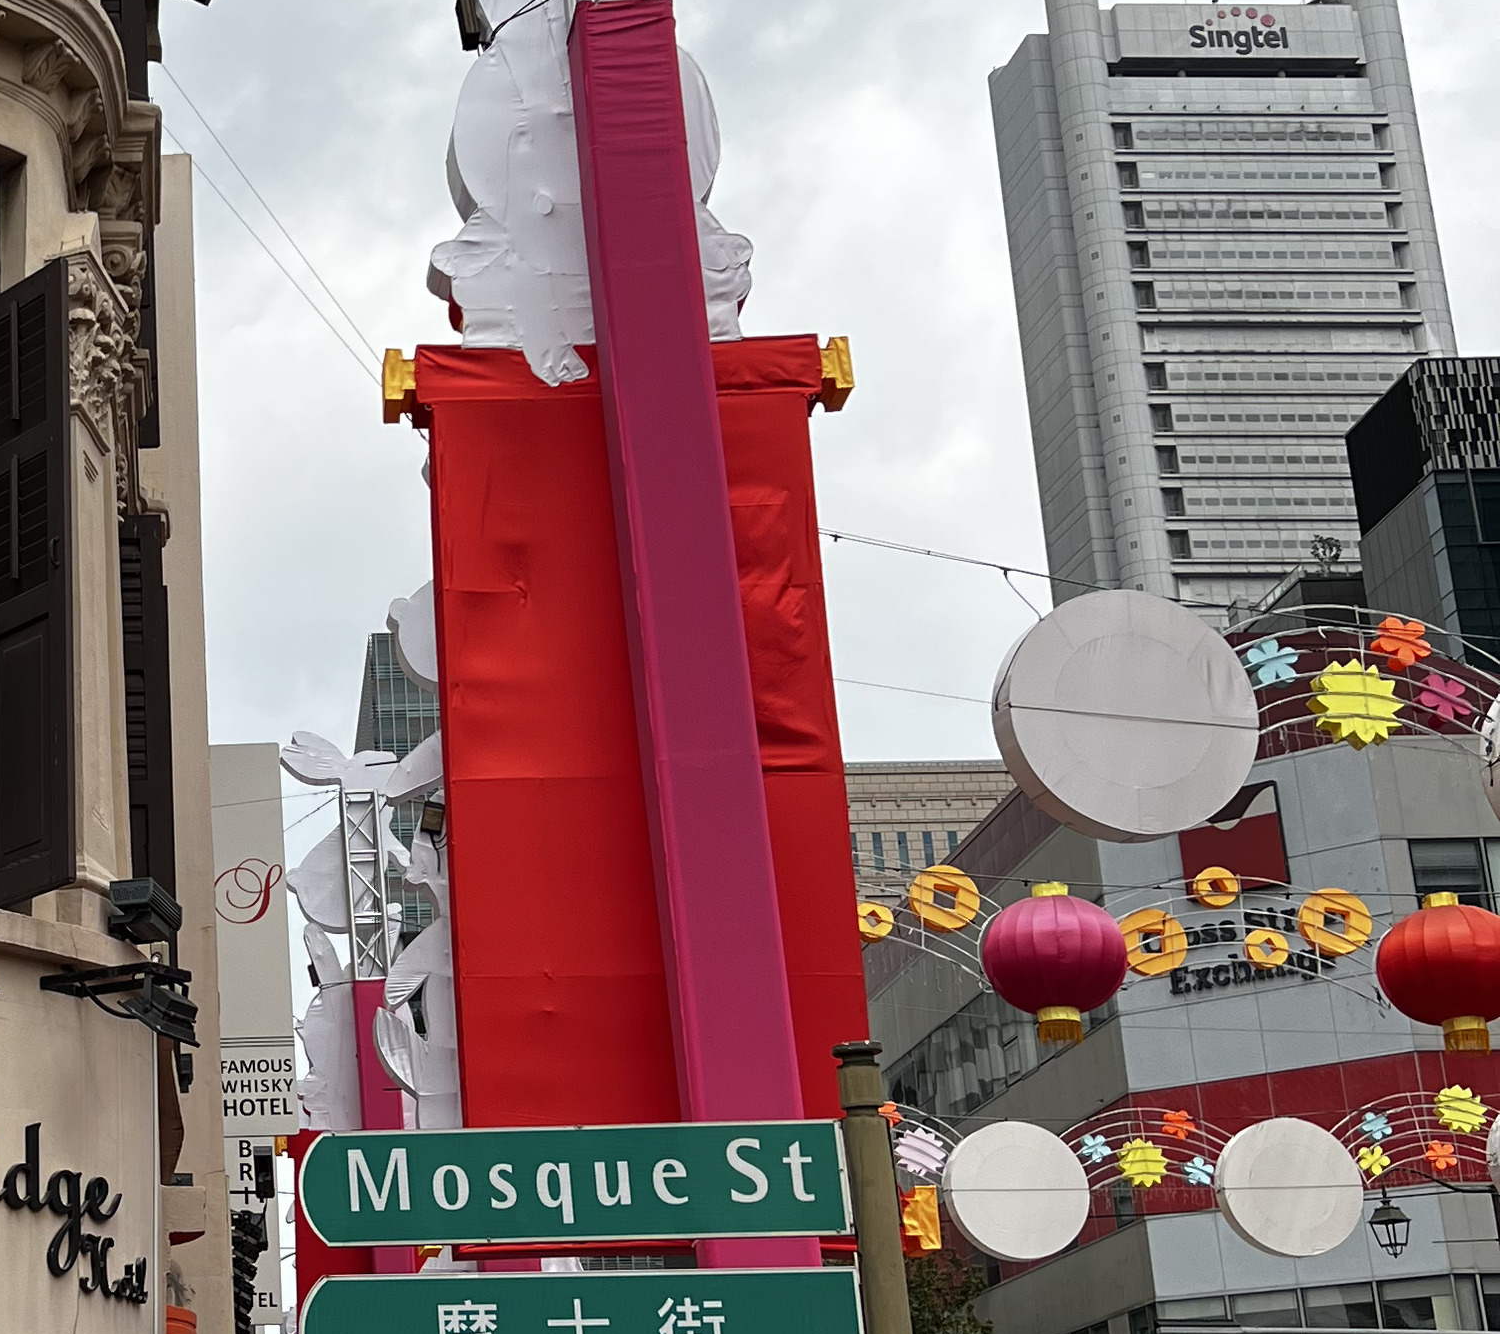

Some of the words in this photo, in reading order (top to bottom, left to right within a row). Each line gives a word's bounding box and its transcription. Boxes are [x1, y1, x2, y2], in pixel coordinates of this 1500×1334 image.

[1190, 25, 1288, 55] Singtel
[1141, 920, 1237, 955] Coss
[221, 1058, 293, 1074] FAMOUS
[221, 1078, 294, 1094] WHISKY
[223, 1097, 293, 1117] HOTEL
[345, 1147, 689, 1225] Mosque
[725, 1137, 816, 1204] St
